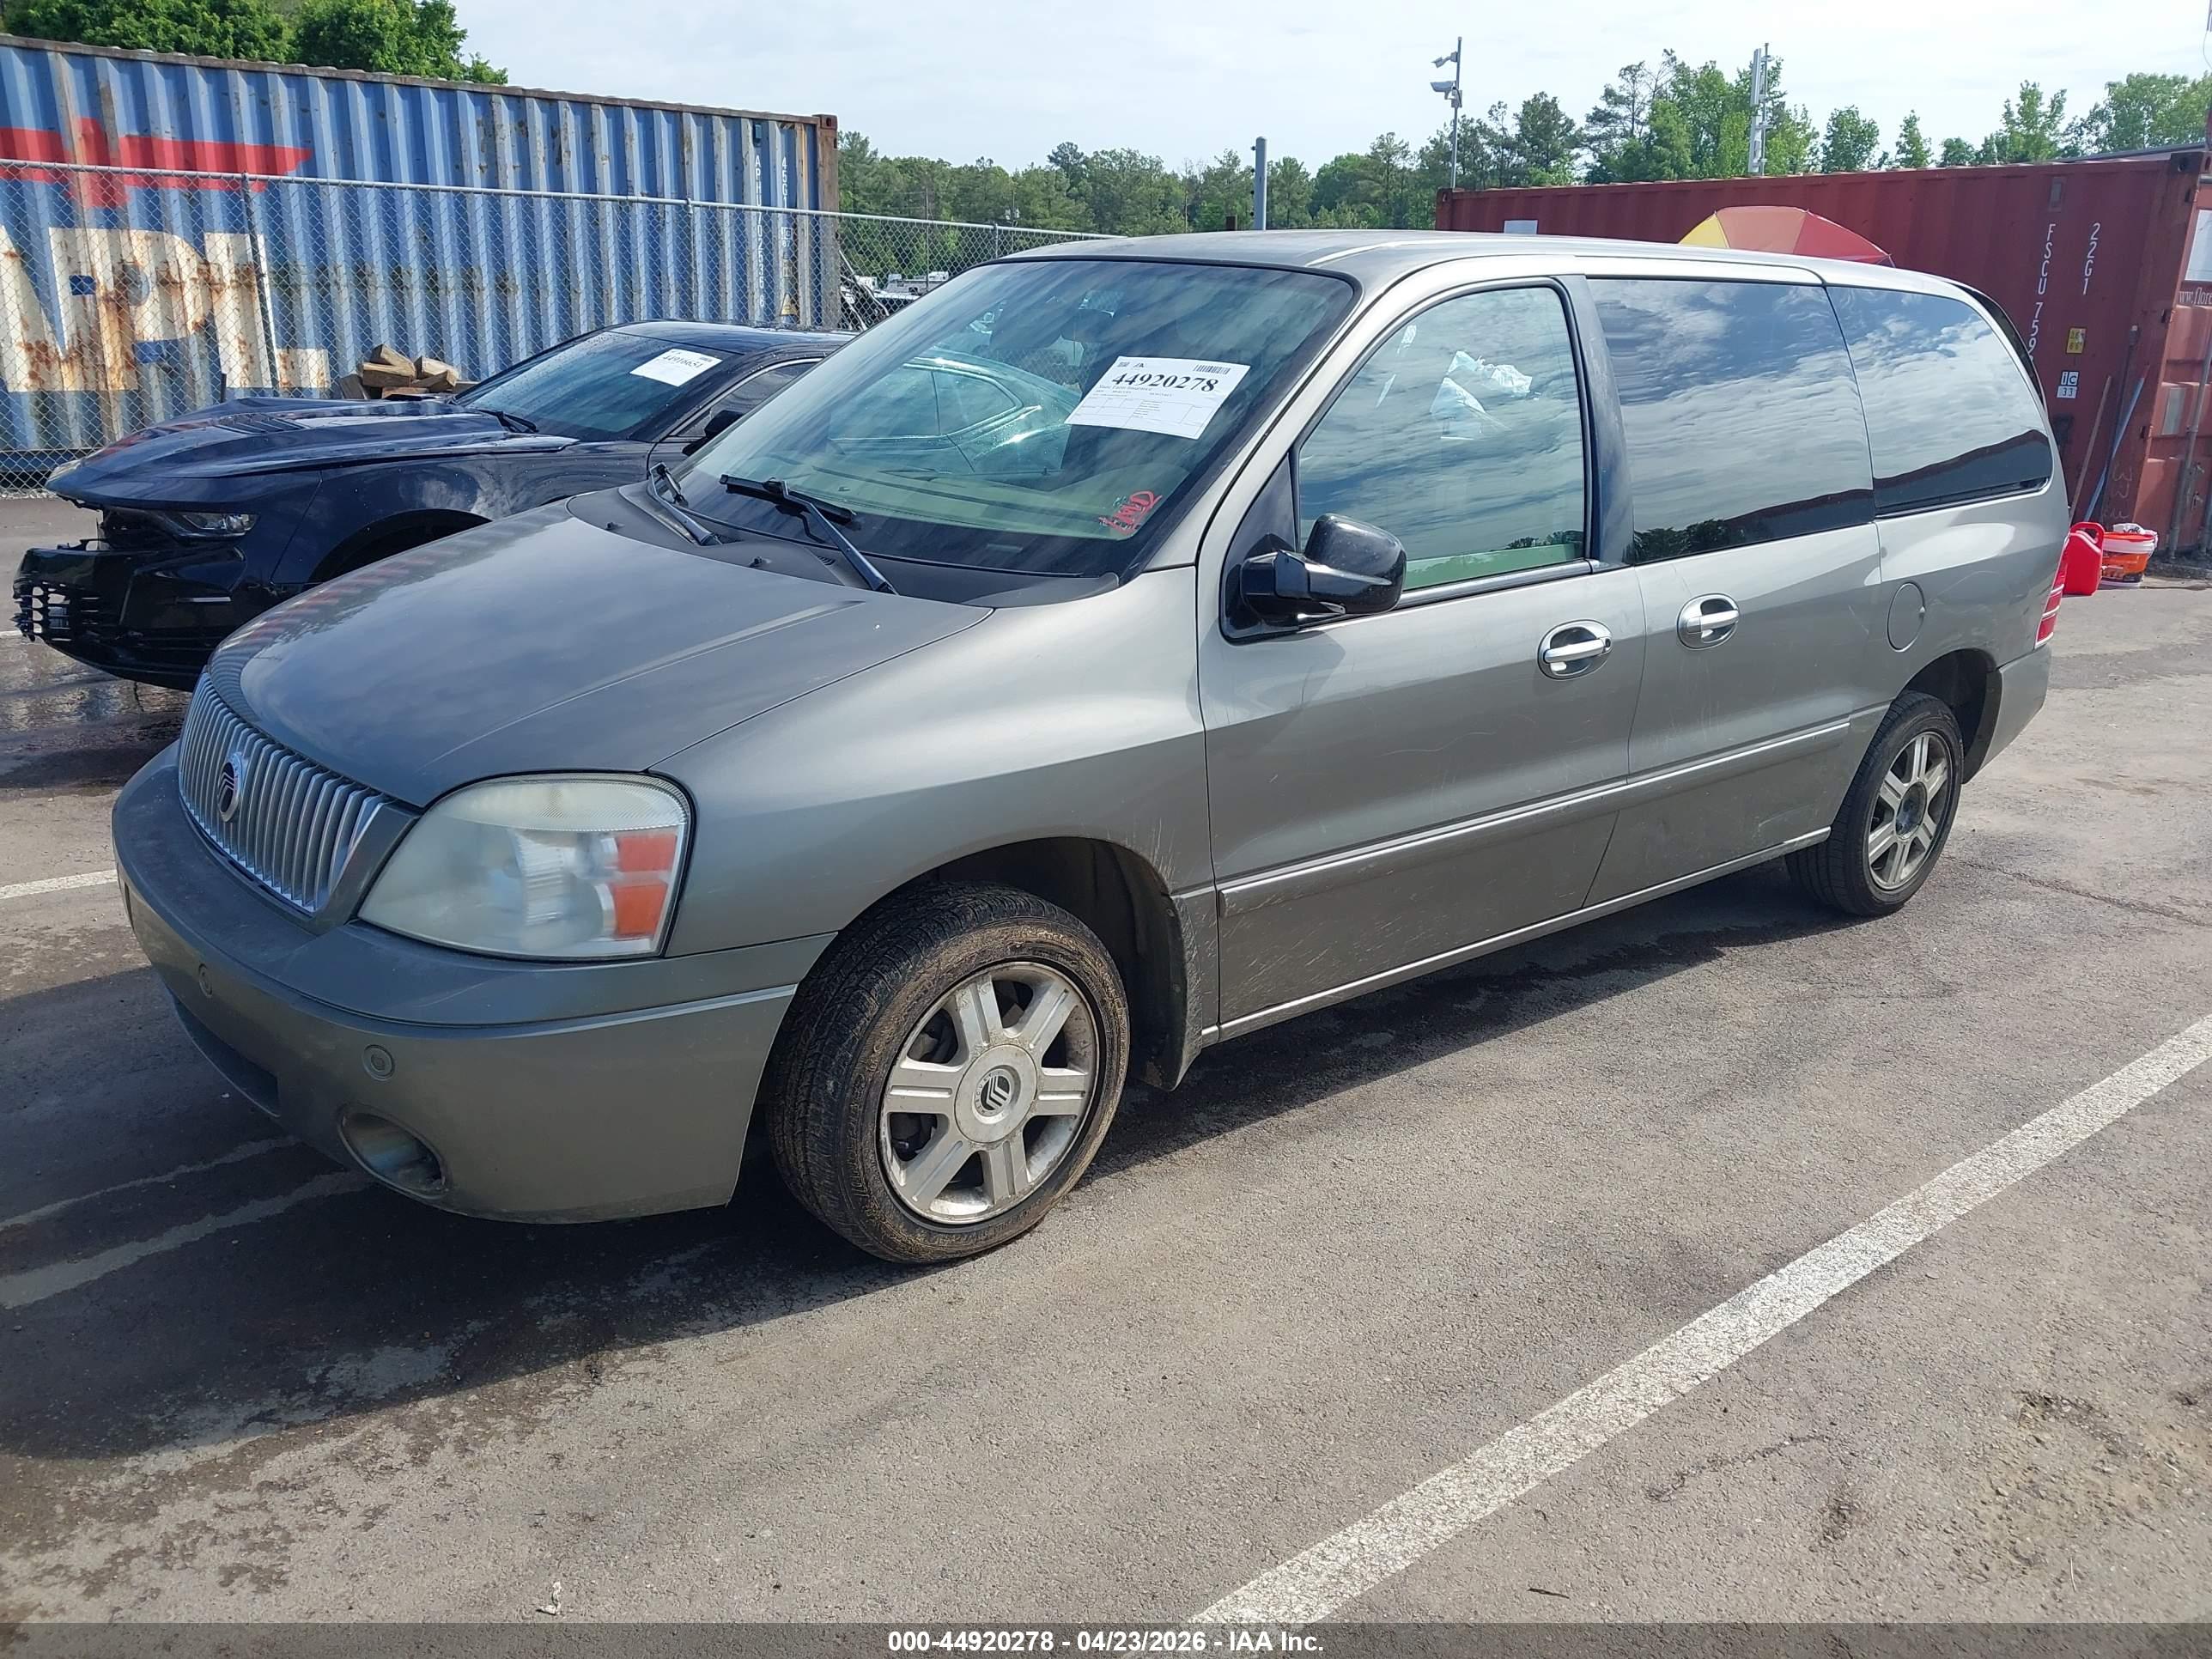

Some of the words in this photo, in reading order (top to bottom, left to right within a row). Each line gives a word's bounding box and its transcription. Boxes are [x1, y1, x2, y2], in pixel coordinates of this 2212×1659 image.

[2038, 223, 2057, 295] FSCU
[2082, 222, 2101, 295] 22G1
[2028, 301, 2044, 361] 759
[1112, 372, 1219, 392] 44920278
